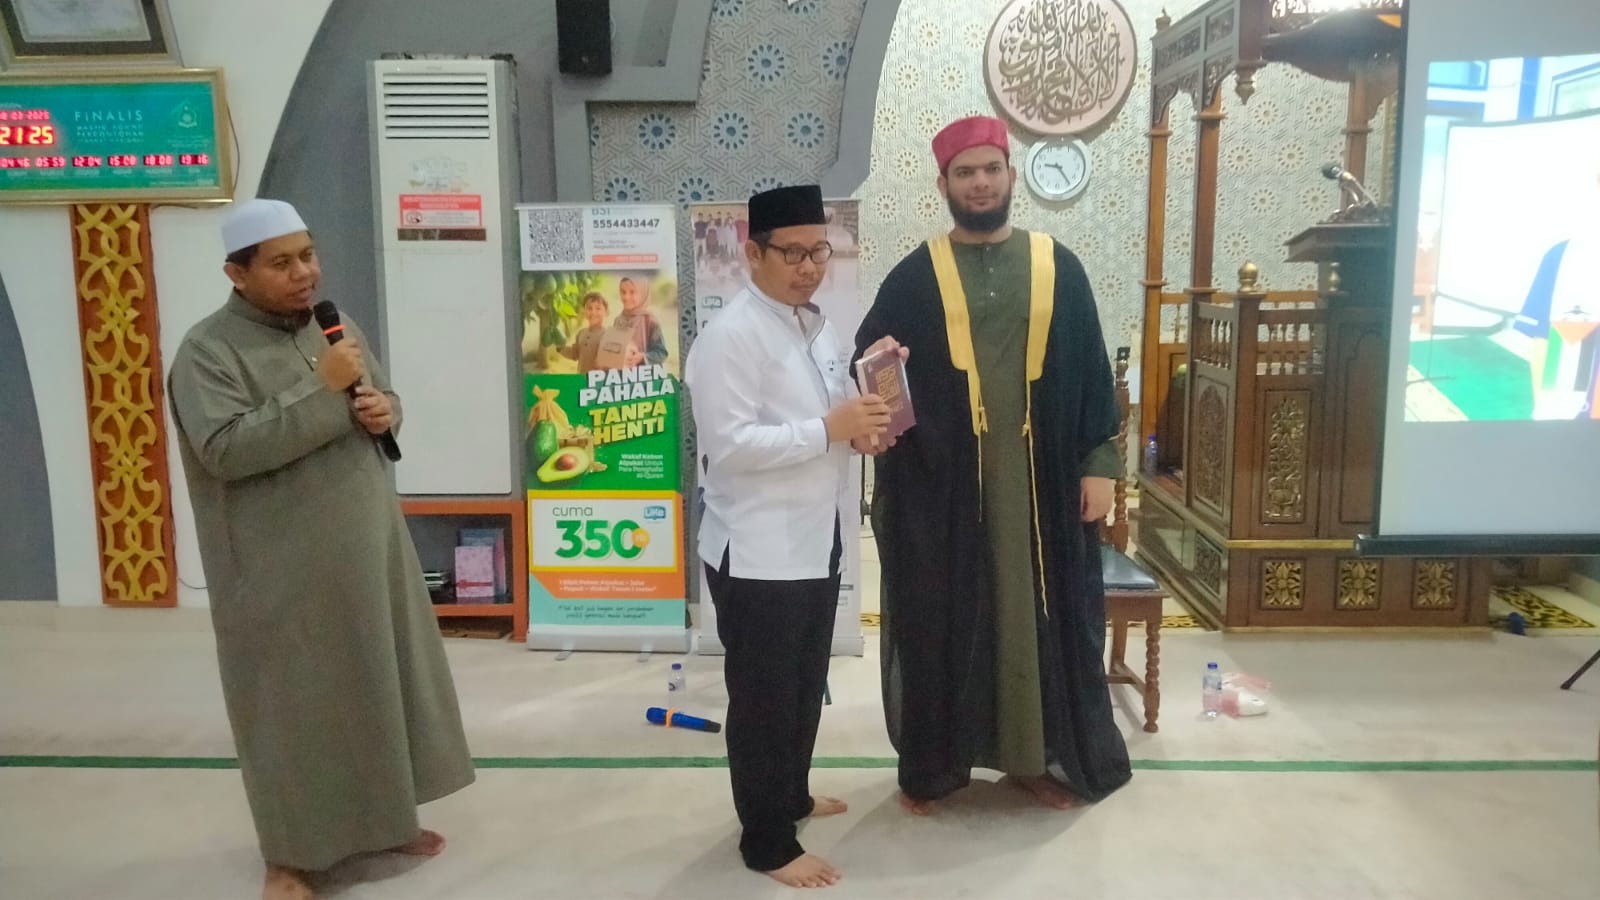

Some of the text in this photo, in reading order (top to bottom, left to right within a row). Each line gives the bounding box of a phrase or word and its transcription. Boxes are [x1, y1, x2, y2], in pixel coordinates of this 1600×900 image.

[74, 110, 144, 121] FINALIS
[593, 219, 660, 229] 5554433447
[588, 364, 667, 388] PANEN
[579, 378, 675, 407] PAHALA
[589, 399, 667, 426] TANPA
[594, 416, 665, 446] HENTI
[552, 506, 593, 517] cuma
[555, 519, 643, 559] 350
